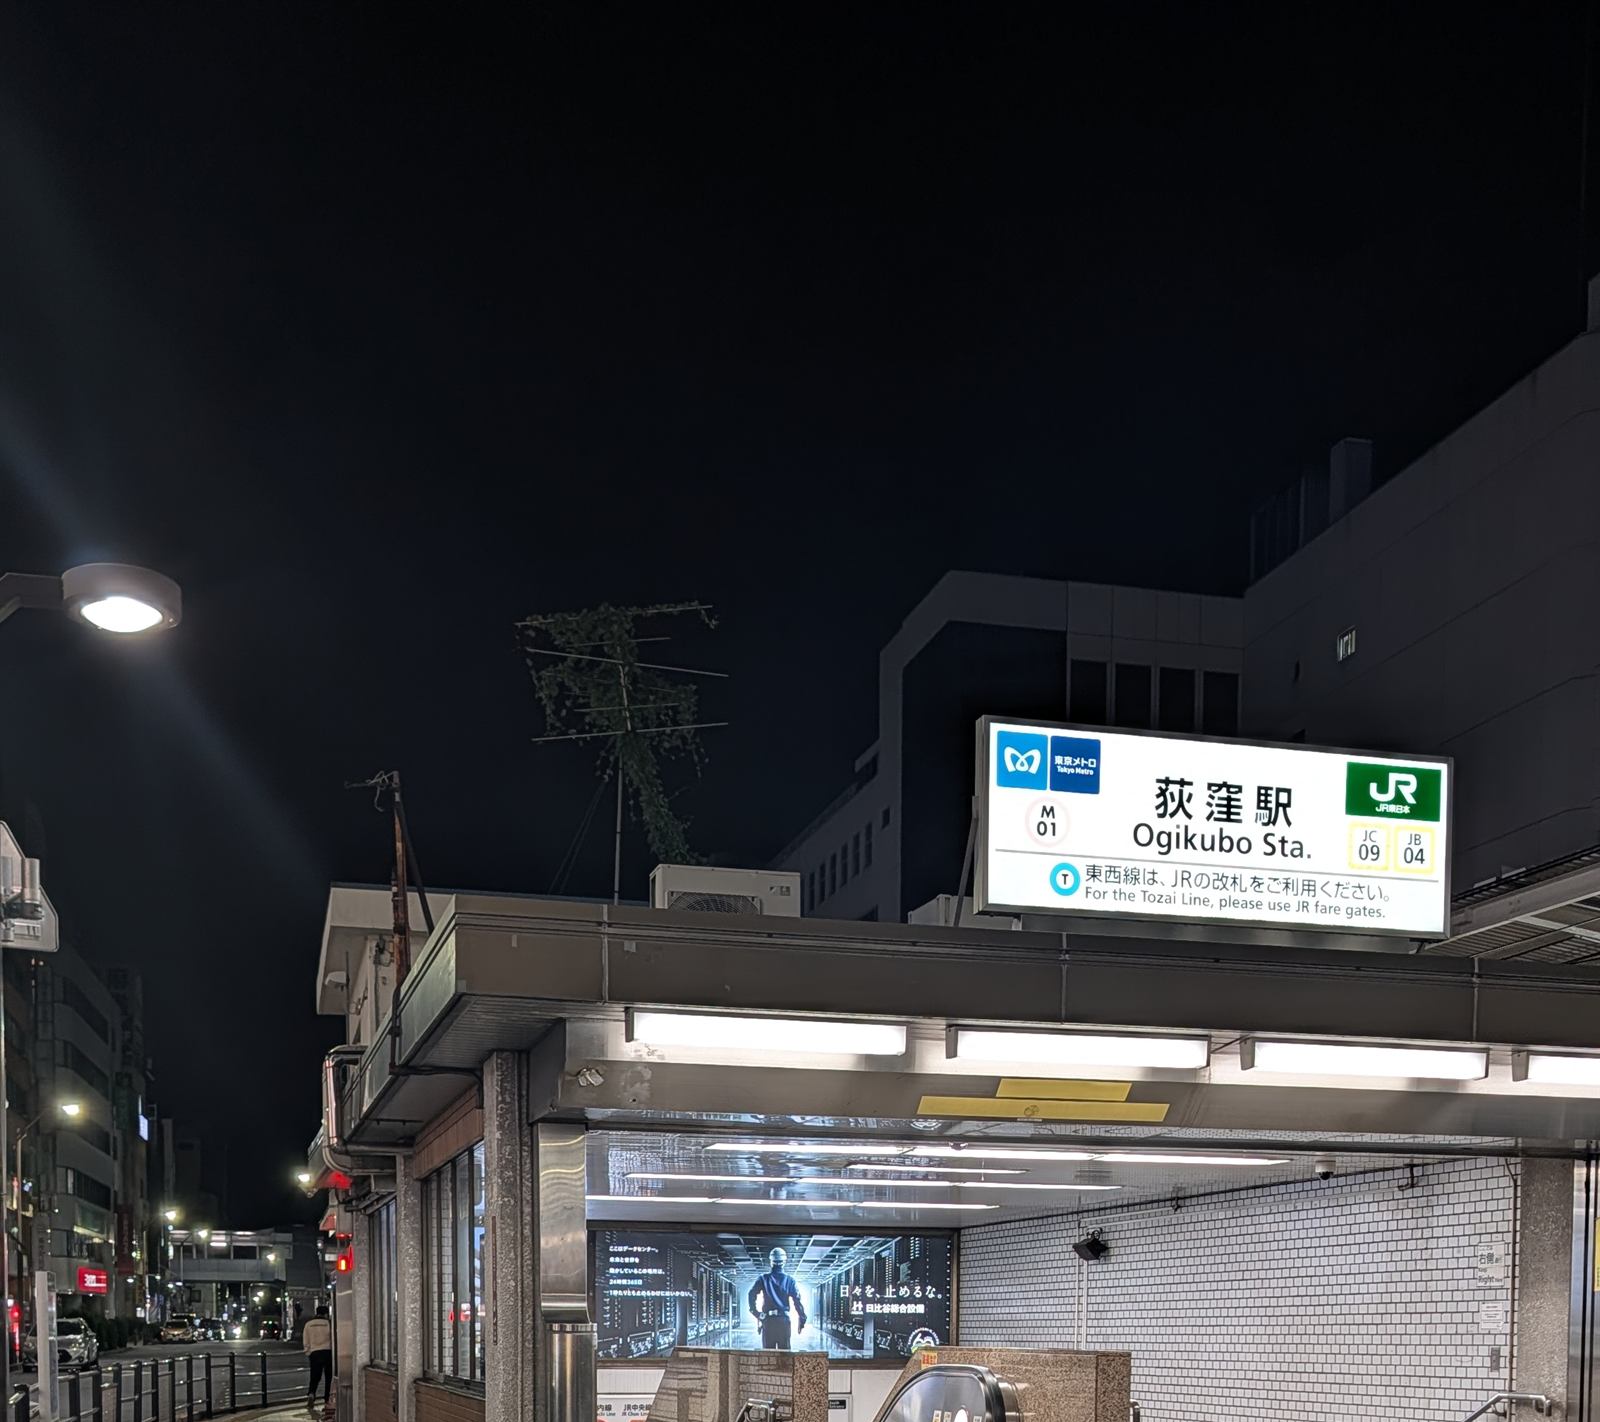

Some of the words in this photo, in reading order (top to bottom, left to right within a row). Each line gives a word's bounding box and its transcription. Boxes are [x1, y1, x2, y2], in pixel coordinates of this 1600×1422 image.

[1054, 755, 1097, 768] 東京メトロ
[1056, 765, 1075, 775] Tokyo
[1075, 768, 1094, 776] Metro
[1369, 772, 1418, 804] JR
[1155, 776, 1292, 828] 荻窪駅
[1375, 803, 1411, 814] JR東日本
[1041, 805, 1056, 819] M
[1036, 820, 1056, 837] 01
[1133, 822, 1253, 856] Ogikubo
[1262, 832, 1312, 859] Sta.
[1363, 830, 1377, 843] JC
[1407, 833, 1422, 846] JB
[1358, 843, 1380, 862] 09
[1403, 847, 1425, 864] 04
[1061, 873, 1069, 886] T
[1085, 863, 1390, 902] 東西線は、JRの改札をご利用ください。
[1085, 886, 1108, 900] For
[1112, 888, 1136, 902] the
[1141, 890, 1176, 905] Tozai
[1182, 892, 1215, 909] Line,
[1219, 895, 1263, 911] please
[1268, 901, 1291, 912] use
[1295, 901, 1310, 913] JR
[1314, 902, 1341, 915] fare
[1345, 905, 1386, 919] gates.
[840, 1284, 943, 1299] 日々を、止めるな。
[865, 1304, 925, 1314] 日比谷総合設備
